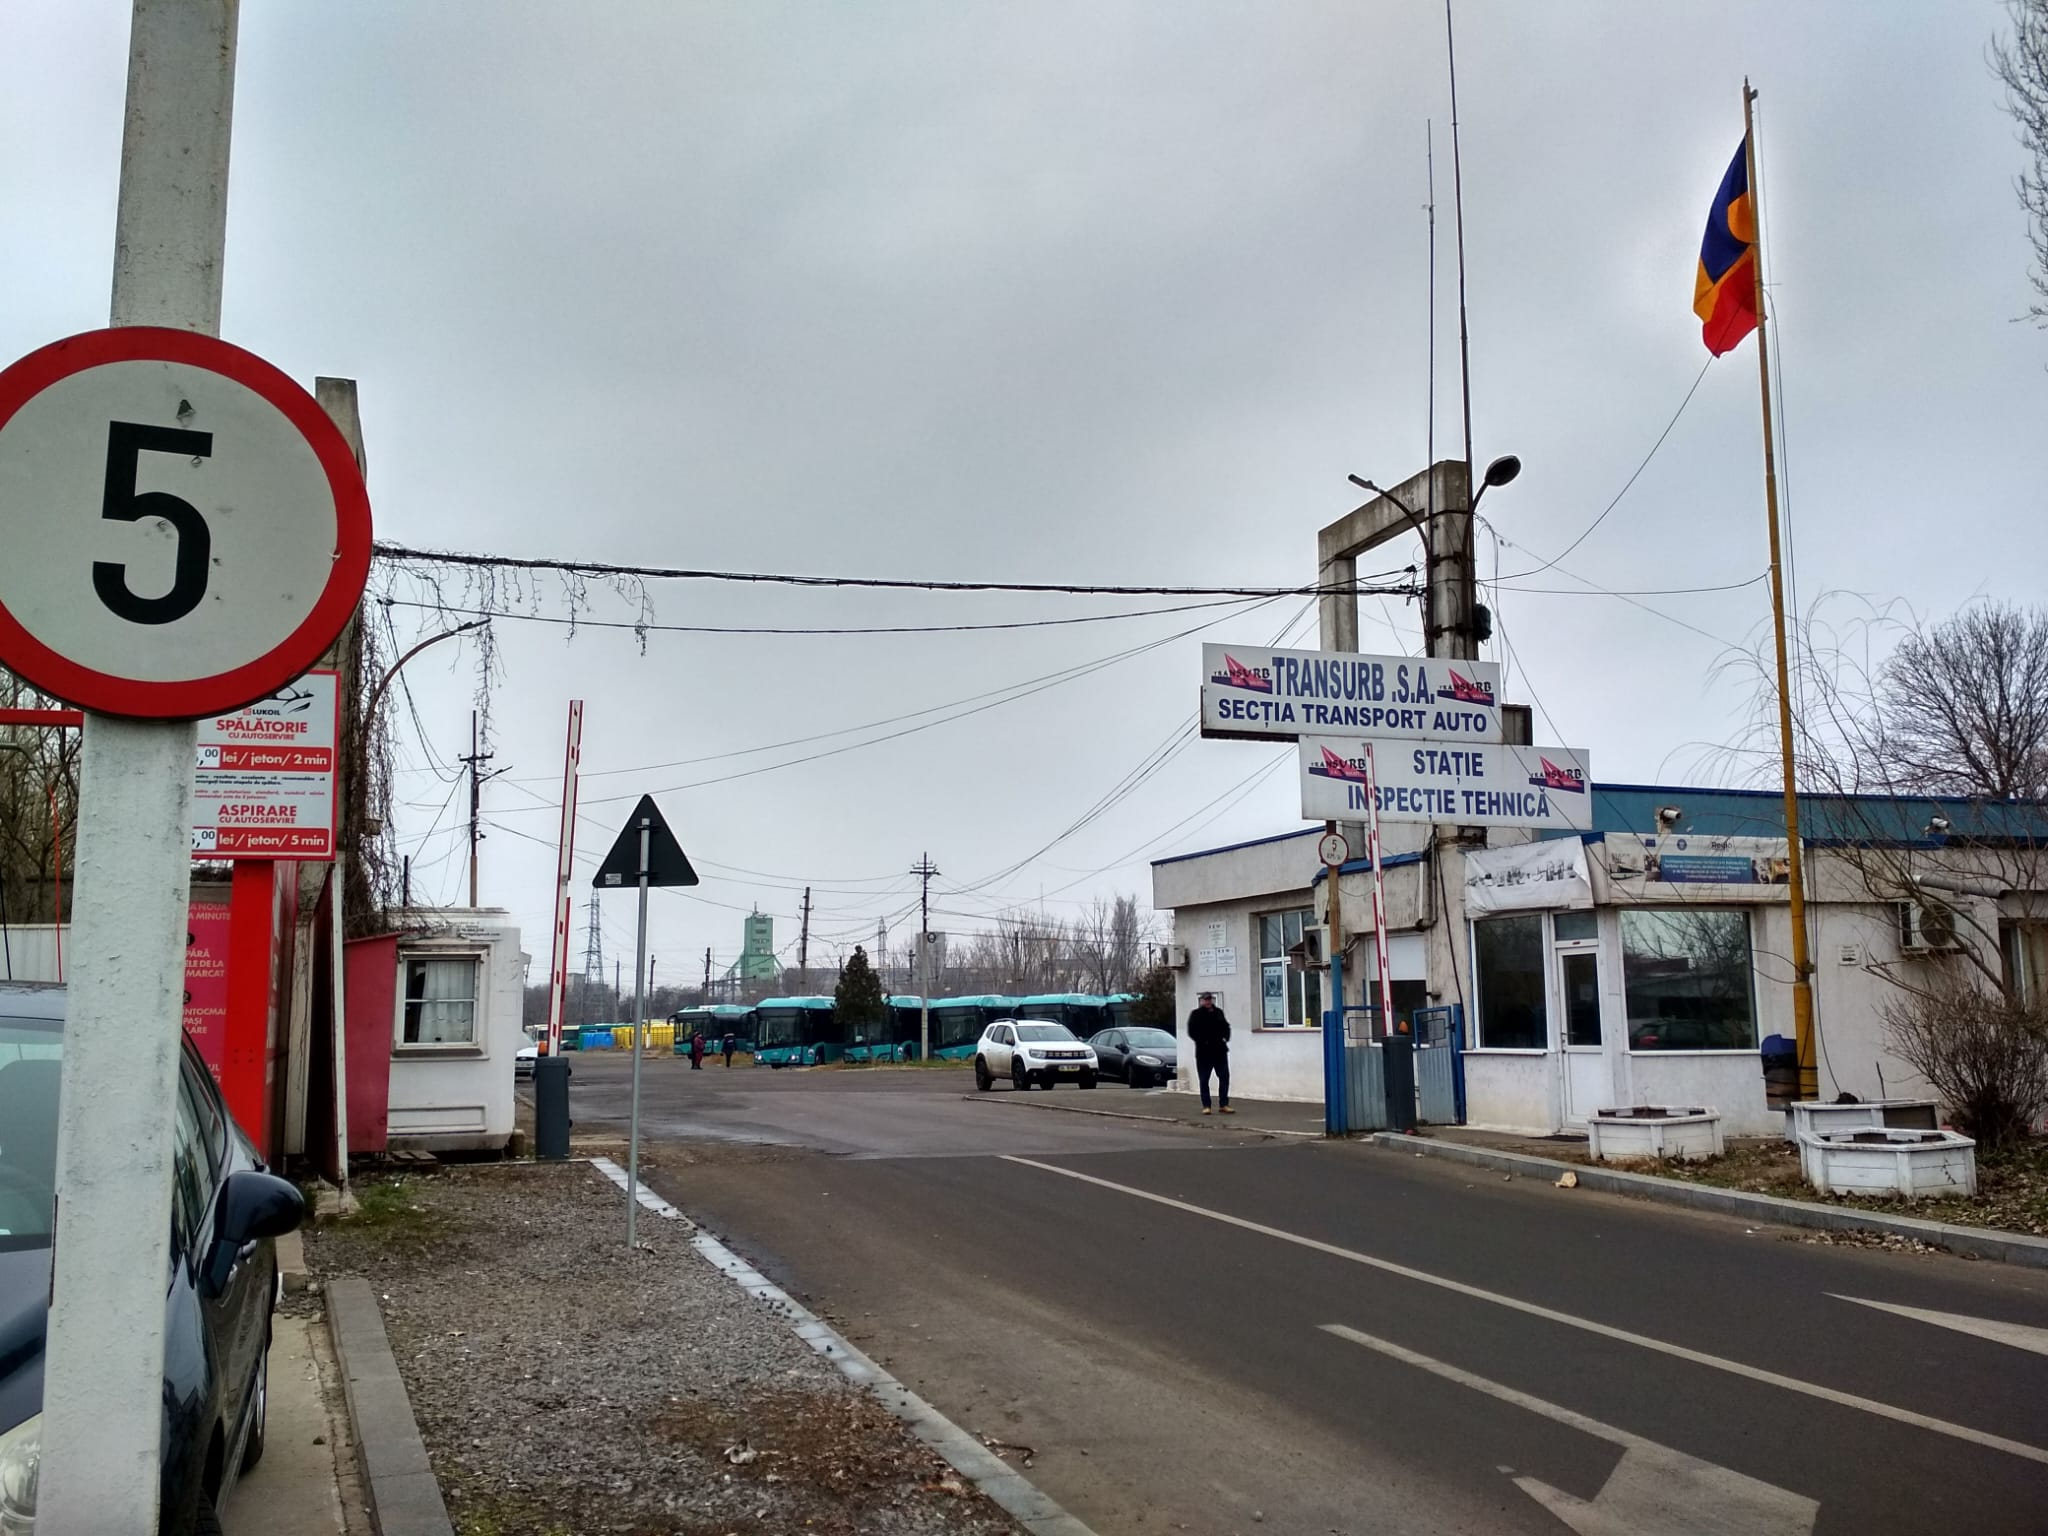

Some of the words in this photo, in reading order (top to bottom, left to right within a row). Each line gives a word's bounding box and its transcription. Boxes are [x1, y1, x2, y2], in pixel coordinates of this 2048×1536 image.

[92, 420, 214, 625] 5
[1271, 656, 1385, 702] TRANSURB
[252, 708, 281, 716] LUKOIL
[1218, 698, 1296, 728] SECȚIA
[1301, 703, 1427, 730] TRANSPORT
[1433, 711, 1488, 733] AUTO
[216, 718, 308, 733] SPĂLĂTORIE
[240, 732, 296, 741] AUTOSERVIRE
[222, 751, 237, 763] lei
[293, 753, 303, 764] 2
[304, 754, 328, 766] min
[1413, 749, 1484, 785] STAȚIE
[218, 804, 298, 817] ASPIRARE
[1347, 785, 1456, 822] INSPECȚIE
[1461, 786, 1551, 818] TEHNICĂ
[219, 816, 231, 824] CU
[232, 816, 296, 825] AUTOSERVIRE
[219, 834, 235, 846] lei
[290, 835, 300, 846] 5
[301, 835, 325, 847] min
[1332, 839, 1338, 852] 5
